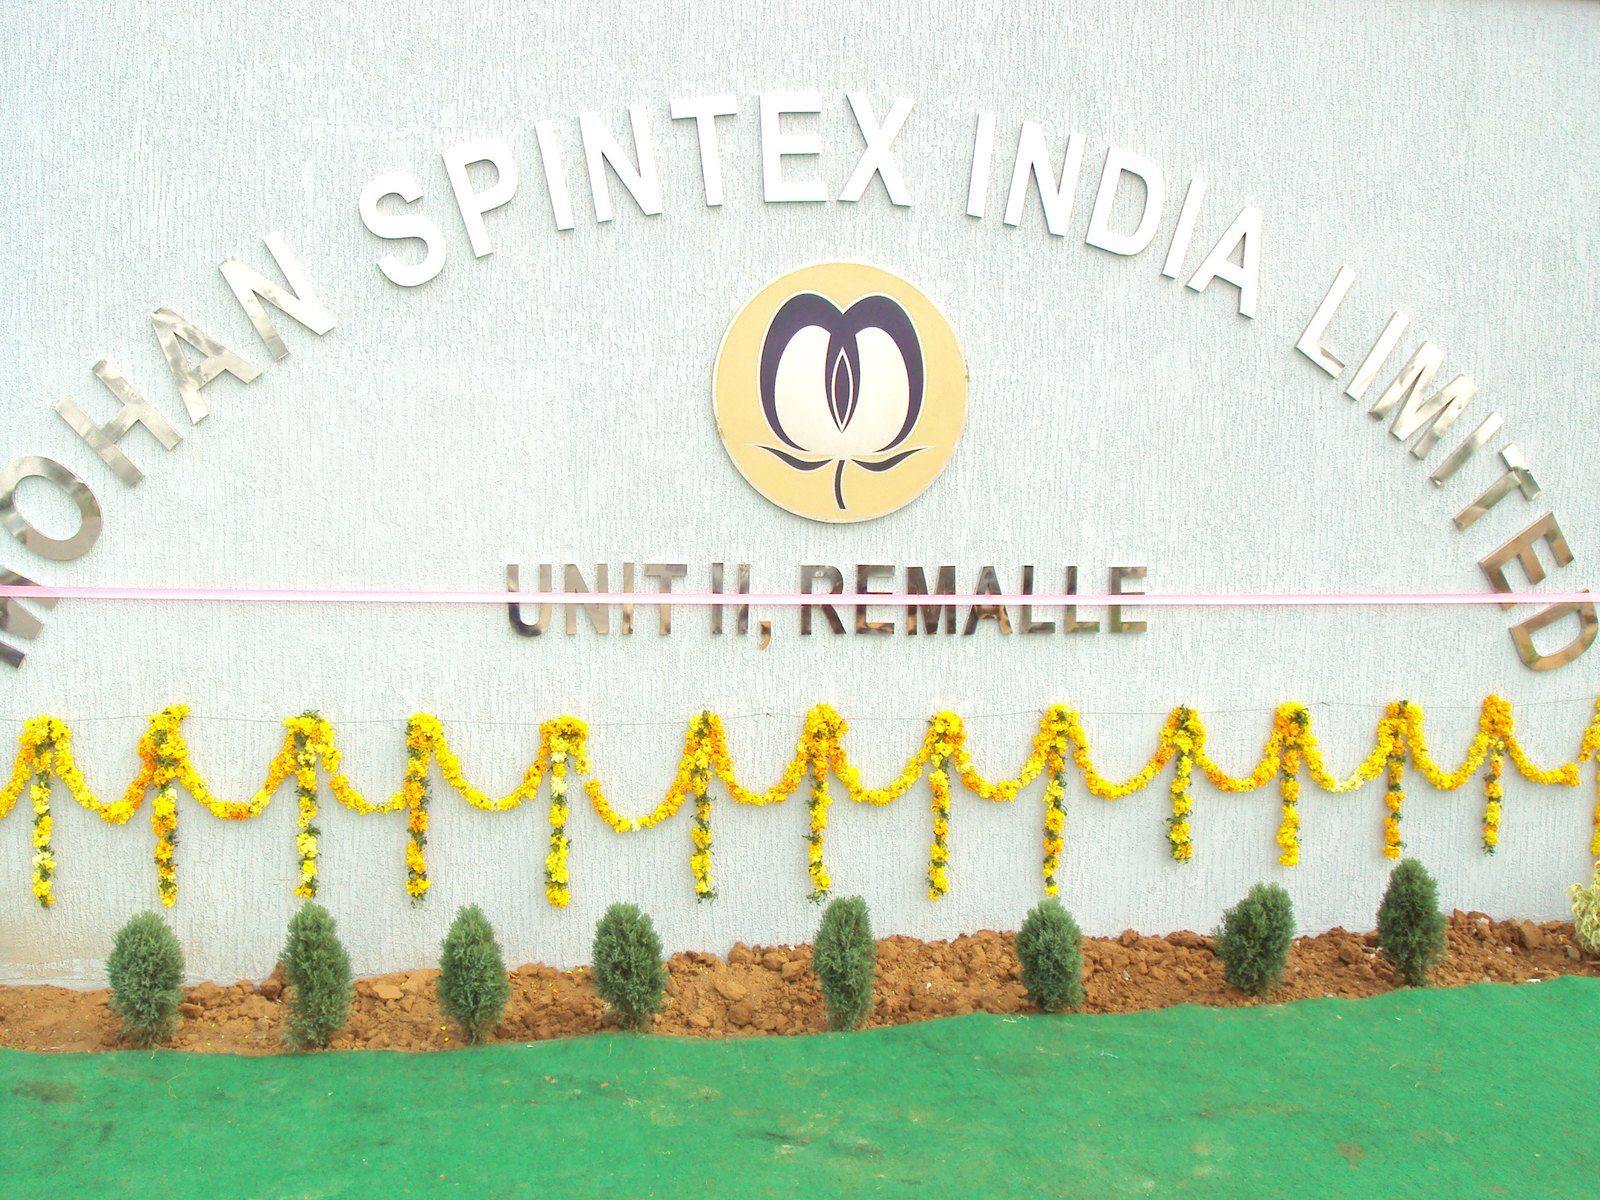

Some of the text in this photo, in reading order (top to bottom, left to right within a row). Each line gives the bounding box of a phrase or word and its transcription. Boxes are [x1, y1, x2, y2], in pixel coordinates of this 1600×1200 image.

[358, 91, 915, 288] SPINTEX
[965, 109, 1264, 319] INDIA
[1295, 262, 1599, 671] LIMITED
[506, 562, 688, 637] UNIT
[800, 563, 1148, 636] REMALLE
